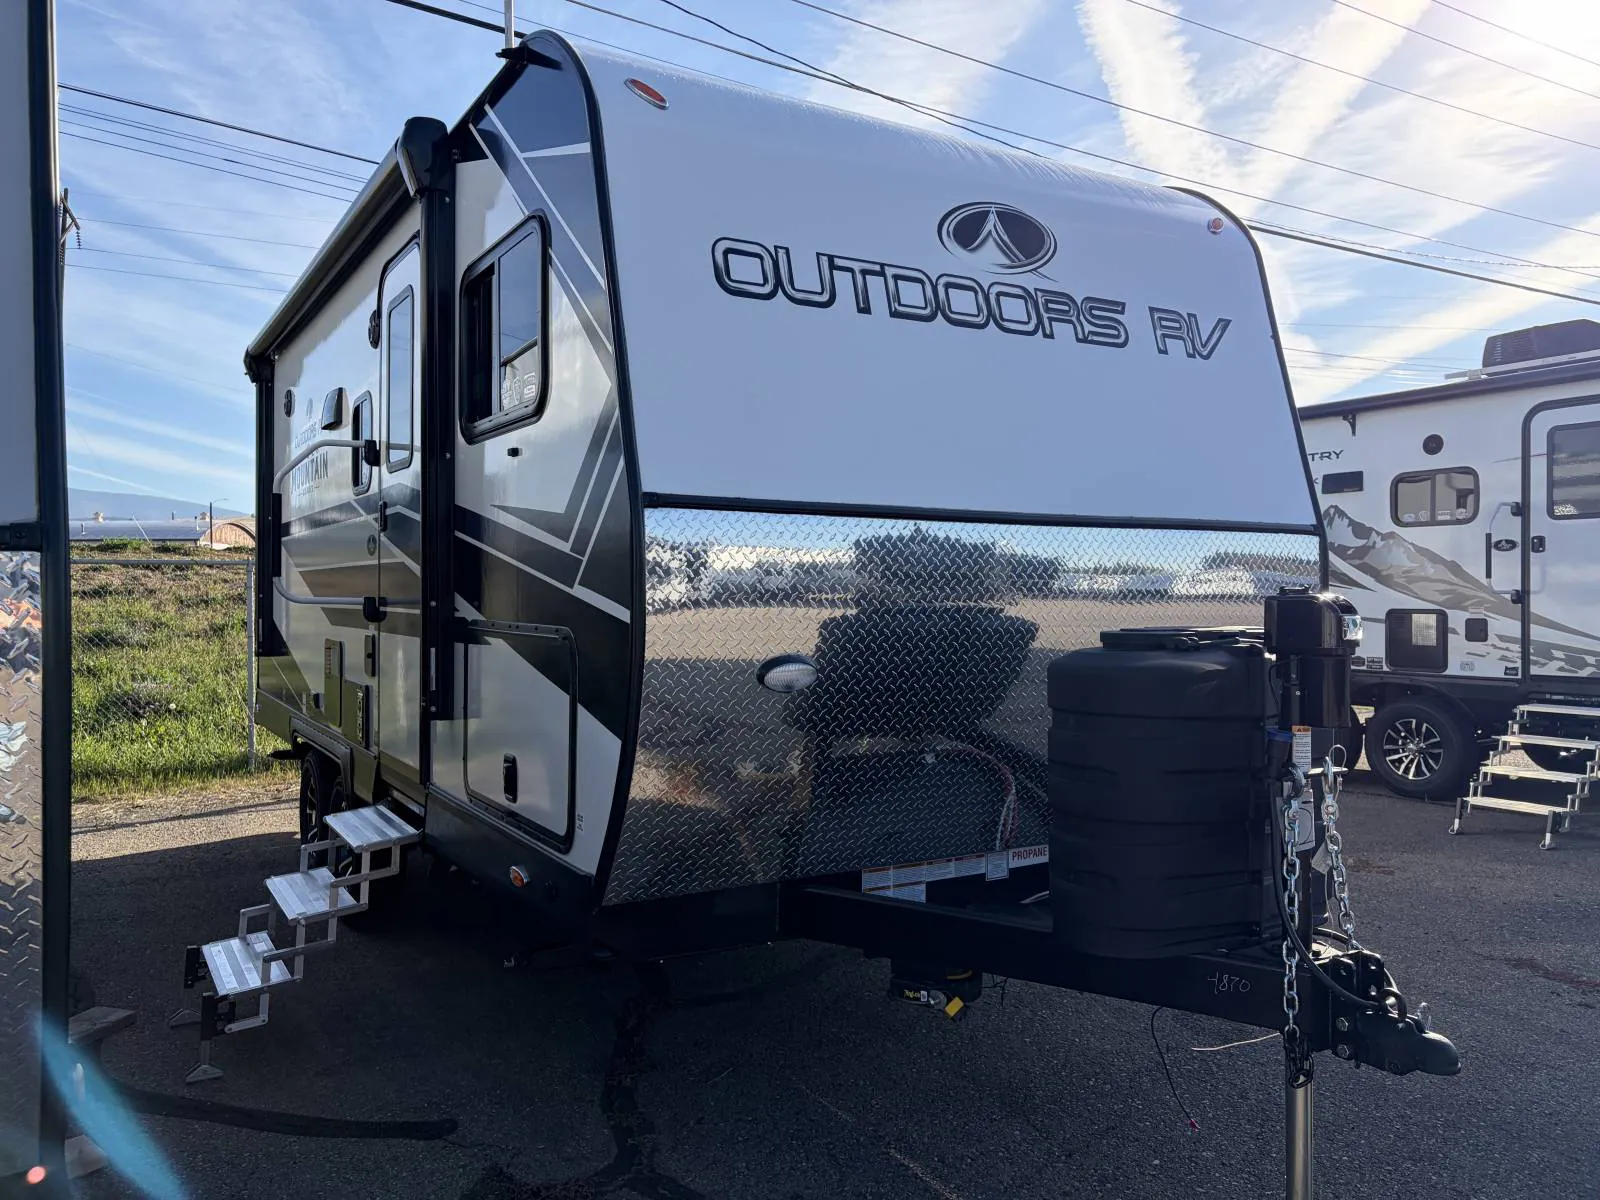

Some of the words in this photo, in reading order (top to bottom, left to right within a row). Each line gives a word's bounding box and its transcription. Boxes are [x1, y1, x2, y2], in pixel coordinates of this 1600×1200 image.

[712, 237, 1129, 348] OUTDOORS
[1149, 305, 1232, 360] RV
[1012, 847, 1048, 861] PROPANE
